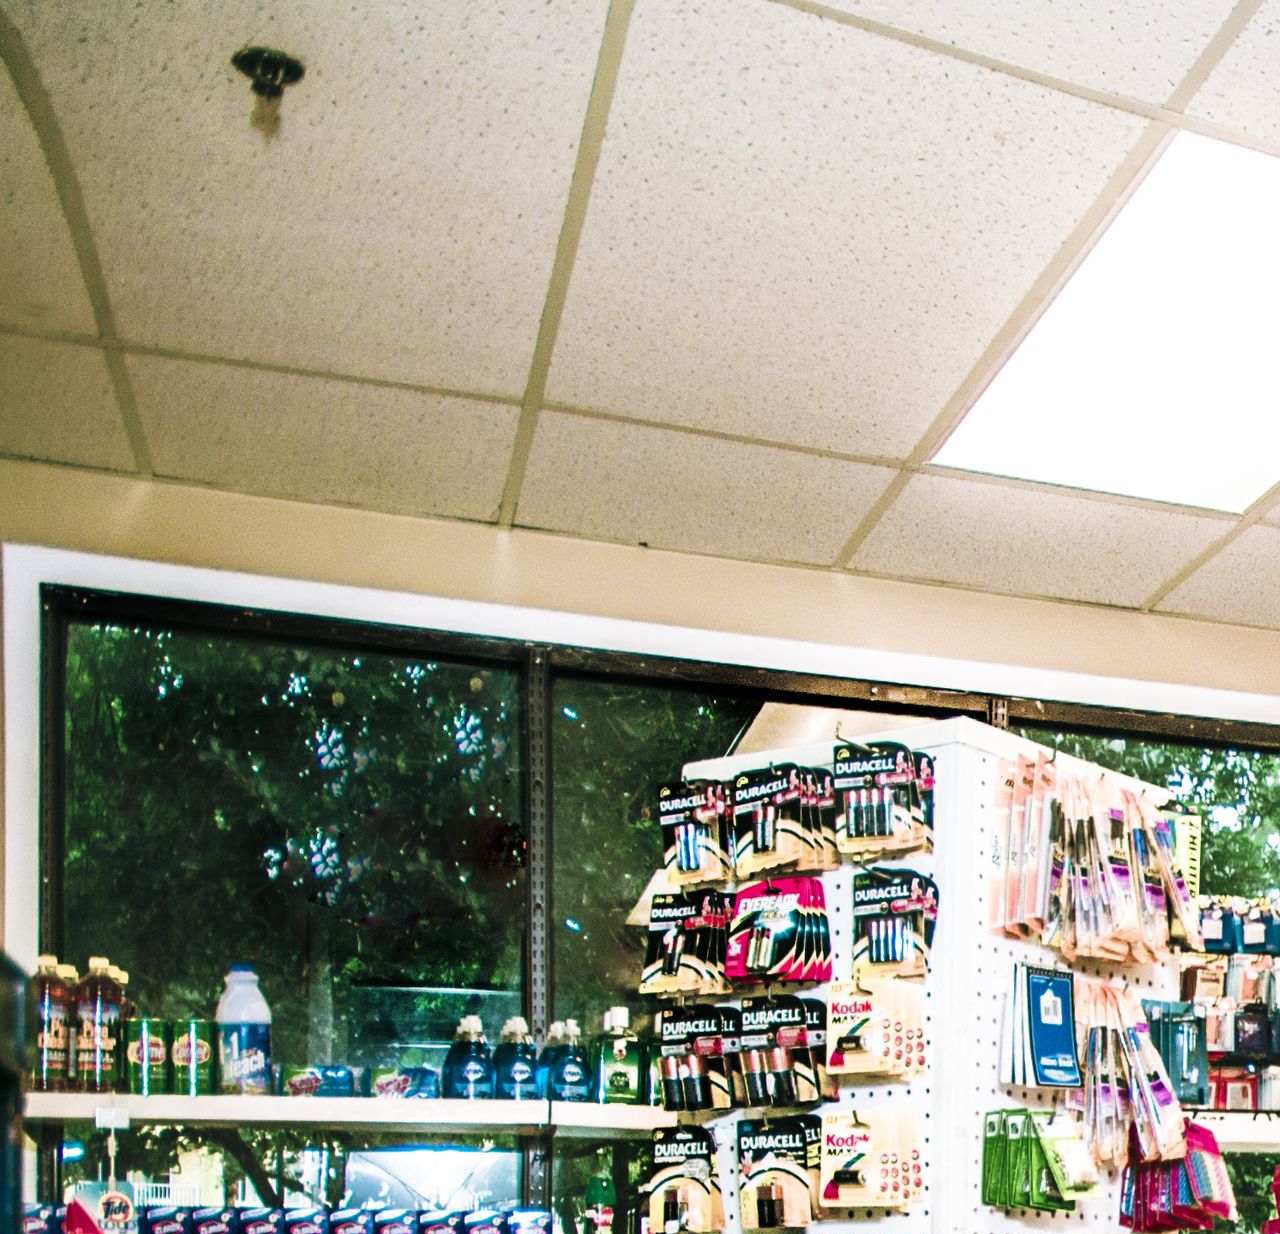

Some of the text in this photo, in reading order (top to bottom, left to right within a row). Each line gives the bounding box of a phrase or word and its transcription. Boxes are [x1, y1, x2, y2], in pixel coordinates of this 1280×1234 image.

[836, 757, 895, 774] DURACELL
[735, 779, 789, 801] DURACELL
[660, 795, 706, 812] DURACELL
[855, 884, 909, 901] DURACELL
[651, 906, 696, 918] DURACELL
[831, 1000, 873, 1015] Kodak
[742, 1009, 801, 1024] DURACELL
[662, 1020, 718, 1035] DURACELL
[740, 1135, 803, 1150] DURACELL
[826, 1134, 870, 1147] Kodak
[654, 1142, 708, 1156] DURACELL
[102, 1199, 130, 1221] Tide
